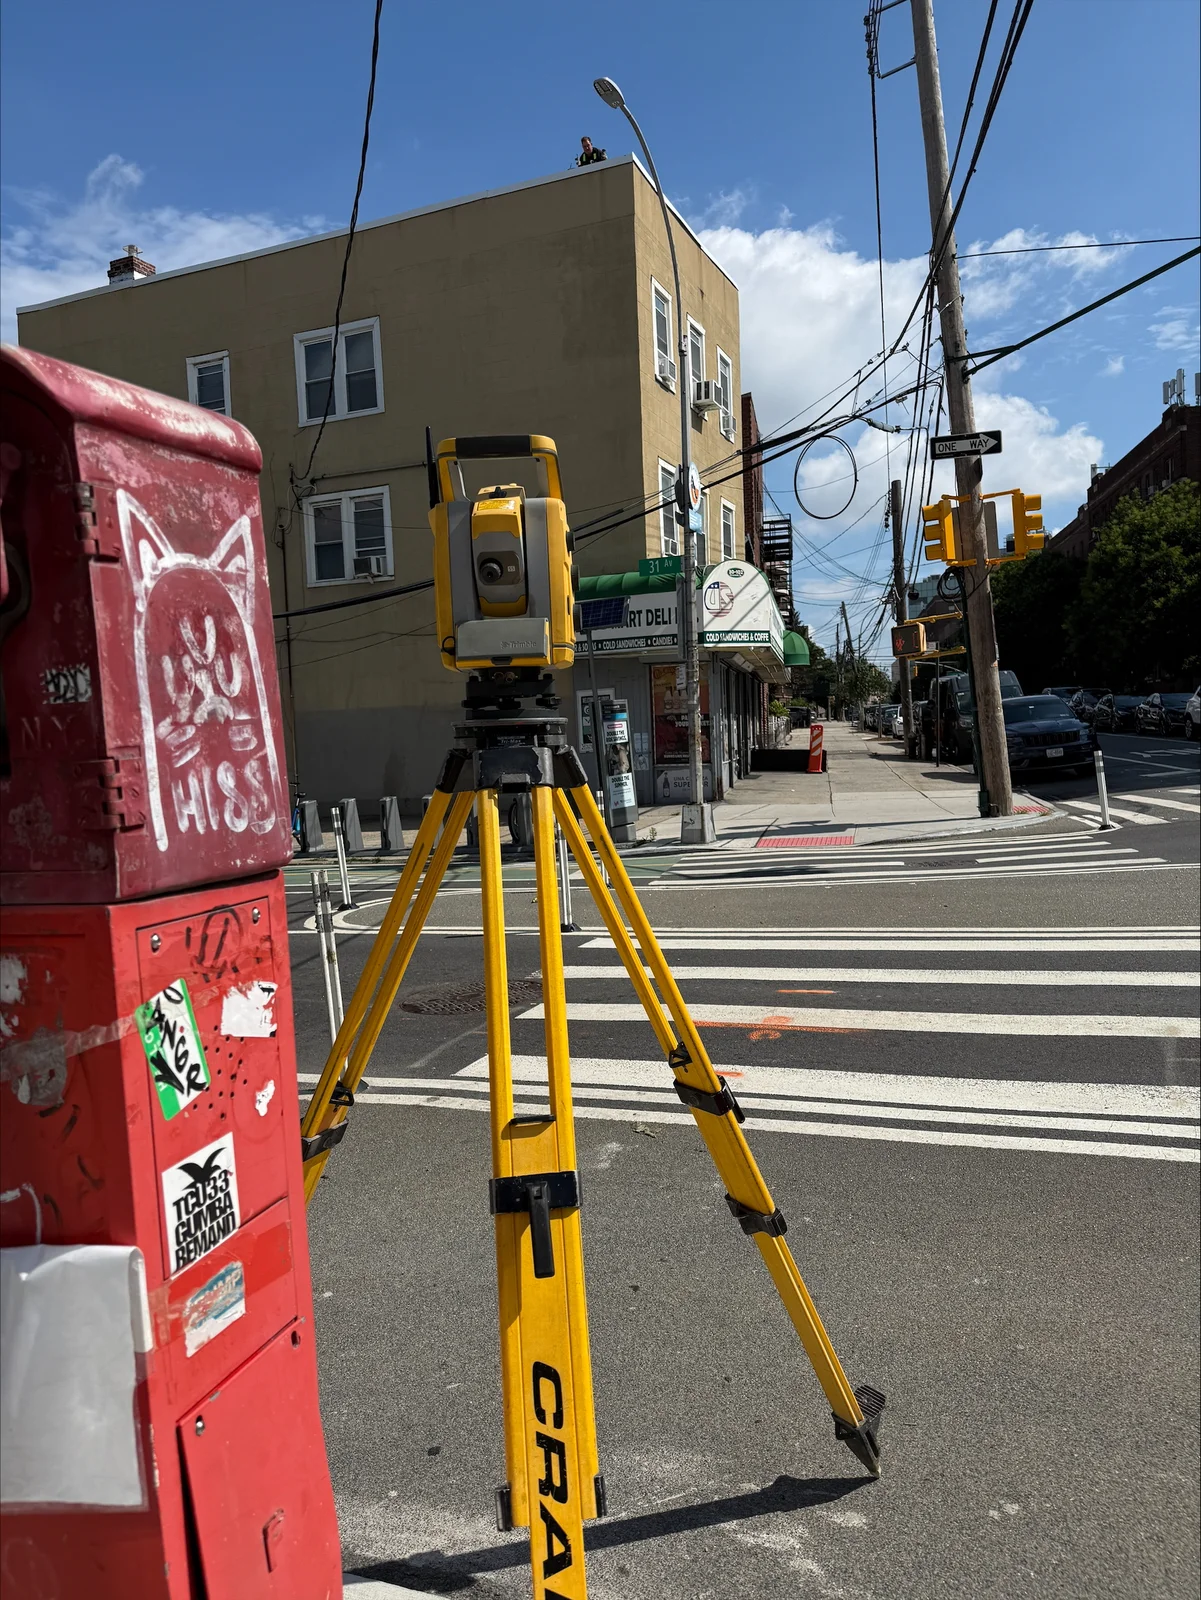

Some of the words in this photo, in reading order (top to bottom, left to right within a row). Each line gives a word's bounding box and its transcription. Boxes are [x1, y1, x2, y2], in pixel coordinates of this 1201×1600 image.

[938, 442, 957, 453] ONE
[969, 439, 990, 449] WAY
[649, 560, 660, 573] 31
[646, 607, 671, 626] DELI
[602, 641, 617, 650] COLD
[652, 636, 673, 646] CANDIES
[706, 633, 720, 642] COLD
[532, 1361, 574, 1600] CRA
